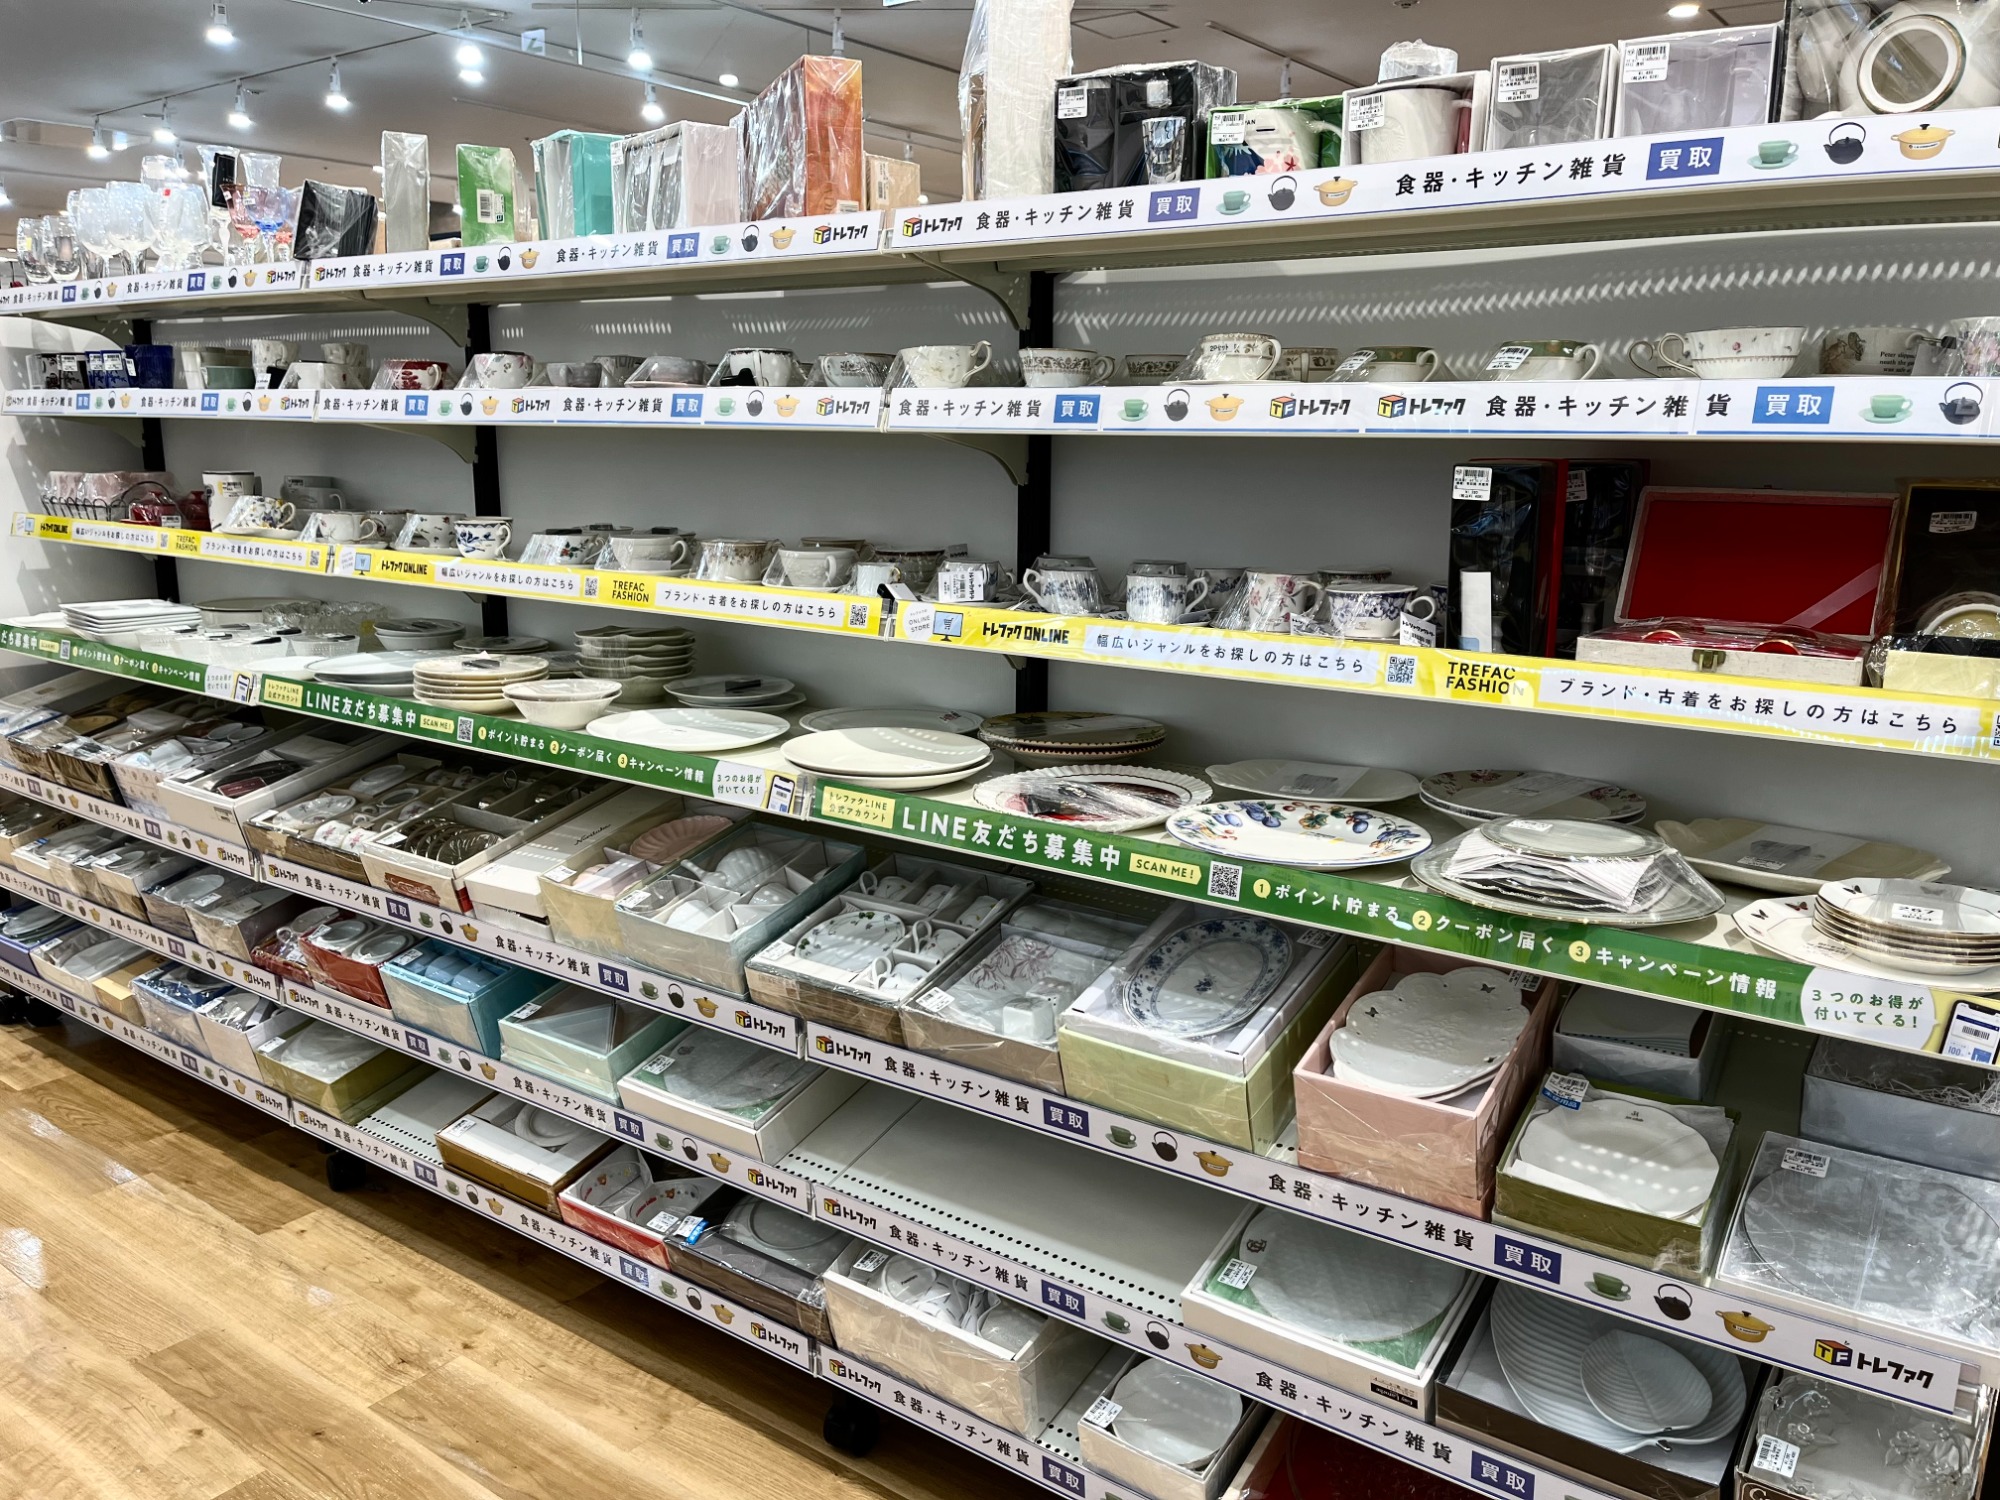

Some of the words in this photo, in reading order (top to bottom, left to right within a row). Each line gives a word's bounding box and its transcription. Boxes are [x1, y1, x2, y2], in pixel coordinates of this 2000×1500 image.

[924, 215, 963, 233] トレファク
[976, 199, 1134, 230] 食器・キッチン雑貨
[1156, 195, 1192, 215] 買取
[1396, 154, 1626, 197] 食器・キッチン雑貨
[1659, 147, 1712, 171] 買取
[353, 259, 433, 277] 食器・キッチン雑貨
[443, 256, 463, 273] 買取
[556, 244, 658, 263] 食器・キッチン雑貨
[670, 237, 697, 255] 買取
[833, 225, 868, 241] トレファク
[141, 396, 197, 408] 食器・キッチン雑貨
[324, 396, 399, 413] 食器・キッチン雑貨
[407, 397, 427, 413] 買取
[525, 398, 550, 412] トレファク
[563, 397, 662, 414] 食器・キッチン雑貨
[674, 396, 700, 414] 買取
[835, 399, 870, 415] トレファク
[899, 398, 1042, 418] 食器・キッチン雑貨
[1061, 399, 1095, 418] 買取
[1298, 398, 1350, 416] トレファク
[1409, 397, 1466, 417] トレファク
[1486, 393, 1731, 419] 食器・キッチン雑貨
[1766, 393, 1822, 418] 買取
[441, 566, 574, 591] 幅広いジャンルをお探しの方はこちら
[612, 579, 645, 592] TREFAC
[612, 590, 650, 604] FASHION
[664, 588, 836, 620] ブランド・古着をお探しの方はこちら
[909, 615, 930, 626] ONLINE
[911, 624, 930, 633] STORE
[1096, 633, 1364, 675] 幅広いジャンルをお探しの方はこちら
[1447, 660, 1516, 681] TREFAC
[1445, 673, 1526, 698] FASHION
[306, 690, 416, 728] LINE友だち募集中
[1558, 677, 1960, 736] ブランド・古着をお探しの方はこちら
[422, 717, 439, 729] SCAN
[488, 730, 545, 750] ポイント貯まる
[560, 744, 612, 764] クーポン届く
[629, 758, 704, 783] キャンペーン情報
[828, 804, 886, 824] 公式アカウント
[902, 806, 1122, 873] LINE友だち募集中
[1136, 859, 1167, 875] SCAN
[1169, 865, 1195, 881] ME!
[1274, 884, 1400, 923] ポイント貯まる
[1436, 916, 1554, 954] クーポン届く
[305, 876, 380, 910] 食器・キッチン雑貨
[390, 900, 408, 918] 買取
[496, 935, 590, 977] 食器・キッチン雑貨
[602, 969, 626, 988] 買取
[753, 1018, 785, 1039] トレファク
[1595, 945, 1778, 1001] キャンペーン情報
[1814, 1006, 1918, 1029] 付いてくる!
[325, 1003, 400, 1041] 食器・キッチン雑貨
[512, 1076, 607, 1123] 食器・キッチン雑貨
[618, 1118, 641, 1137] 買取
[765, 1177, 797, 1198] トレファク
[836, 1042, 872, 1065] トレファク
[883, 1056, 1030, 1115] 食器・キッチン雑貨
[1048, 1105, 1084, 1131] 買取
[1268, 1173, 1474, 1251] 食器・キッチン雑貨
[1503, 1243, 1553, 1276] 買取
[1857, 1352, 1934, 1389] トレファク
[334, 1127, 408, 1171] 食器・キッチン雑貨
[520, 1214, 612, 1267] 食器・キッチン雑貨
[623, 1261, 645, 1281] 買取
[768, 1332, 799, 1354] トレファク
[842, 1206, 877, 1230] トレファク
[889, 1224, 1029, 1292] 食器・キッチン雑貨
[1048, 1287, 1080, 1313] 買取
[1256, 1371, 1452, 1465] 食器・キッチン雑貨
[1480, 1460, 1527, 1493] 買取
[848, 1368, 882, 1394] トレファク
[893, 1389, 1030, 1466] 食器・キッチン雑貨
[1049, 1463, 1080, 1490] 買取
